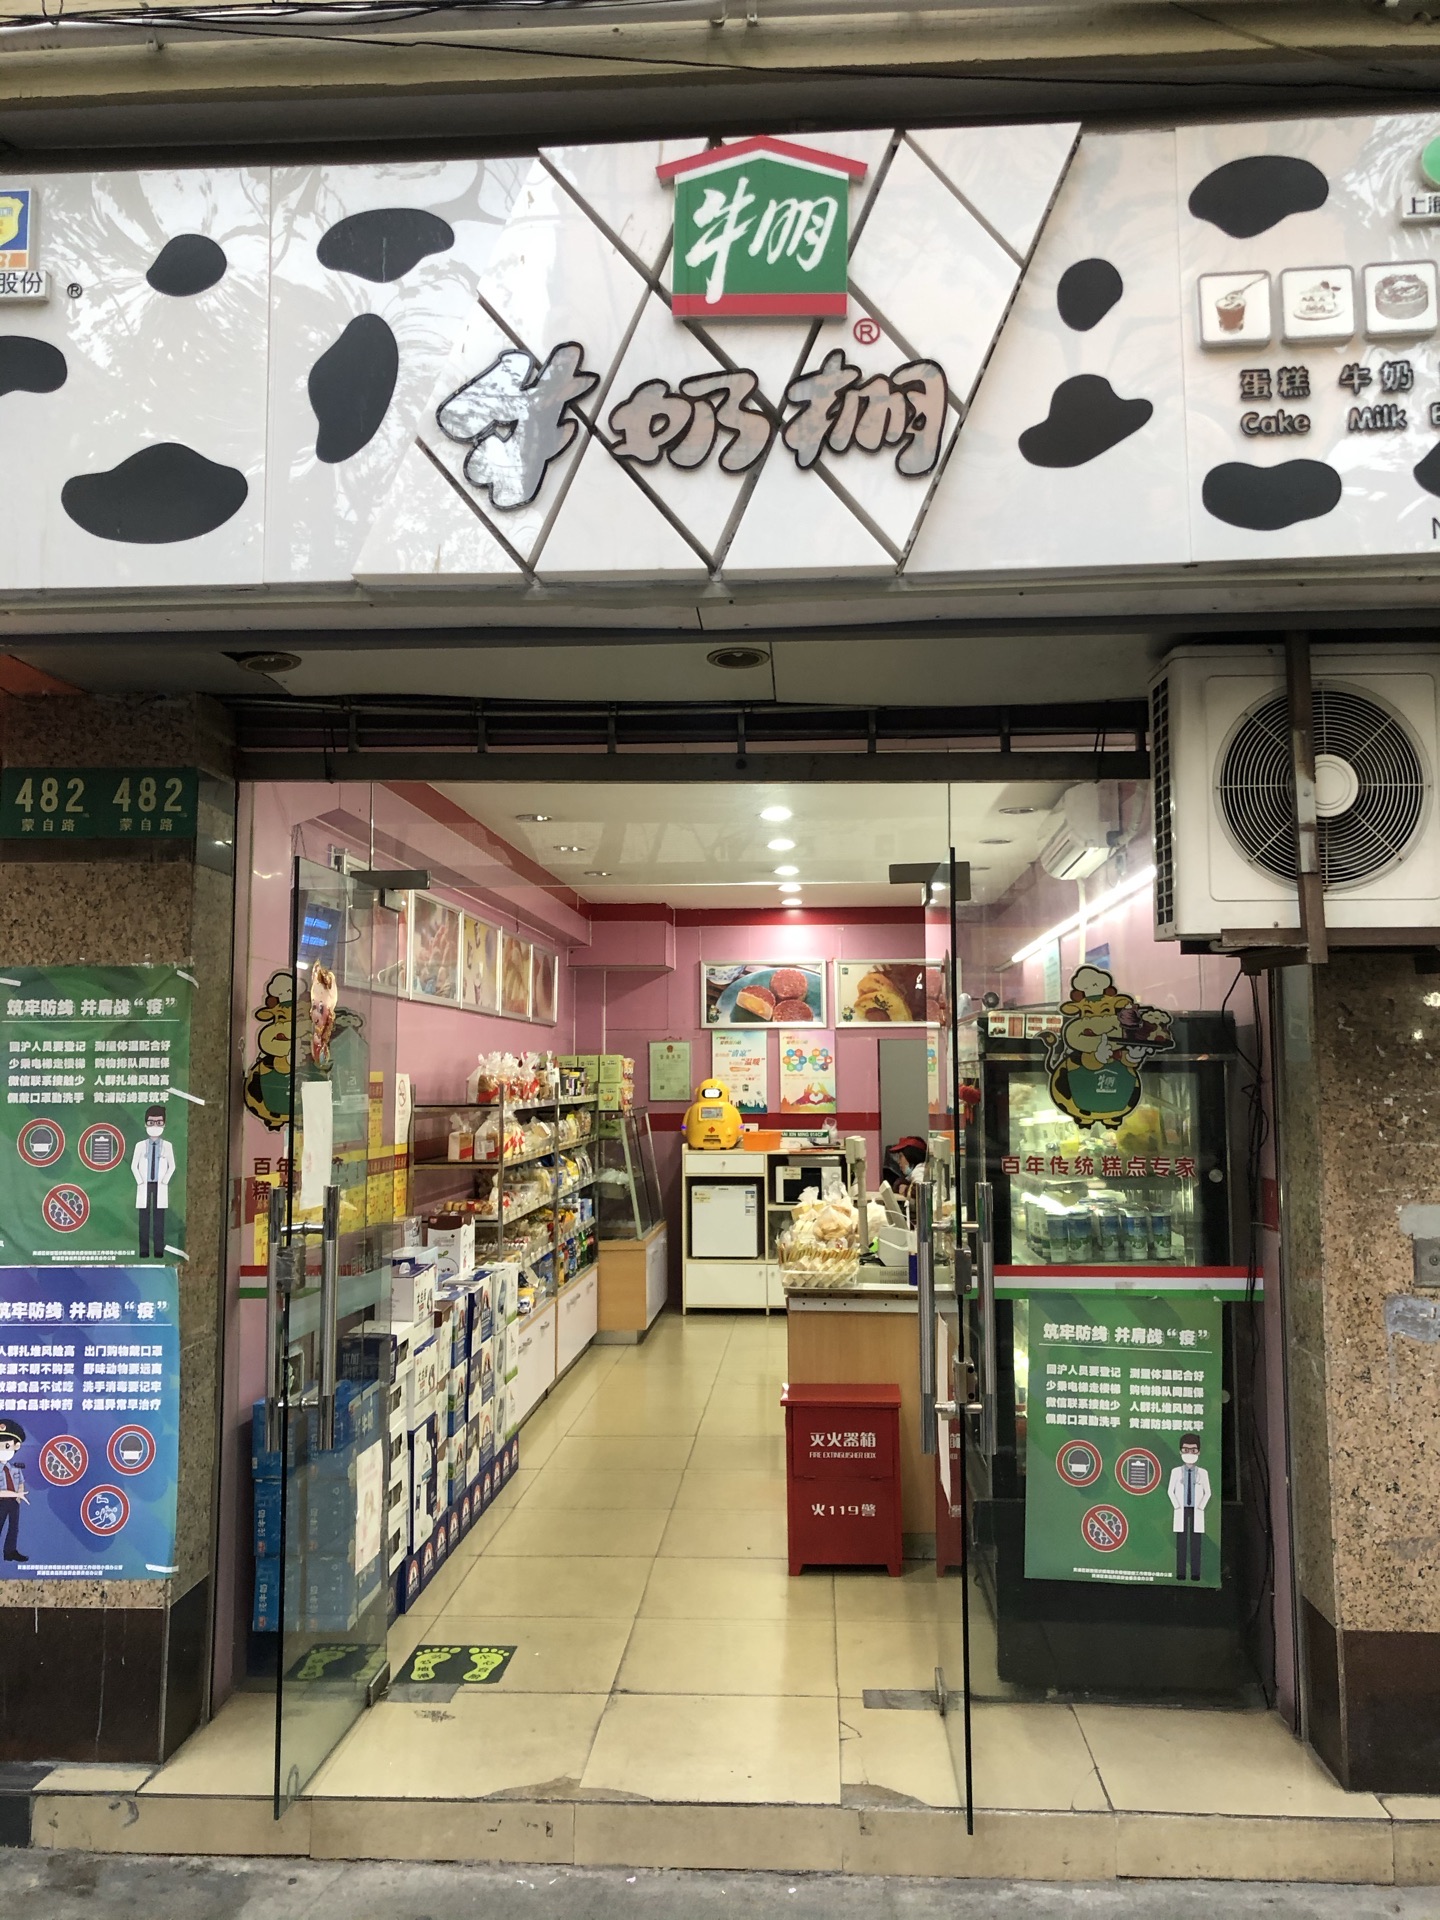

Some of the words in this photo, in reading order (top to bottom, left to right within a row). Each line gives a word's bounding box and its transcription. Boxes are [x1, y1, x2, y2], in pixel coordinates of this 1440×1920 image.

[1240, 366, 1311, 400] 蛋糕
[1339, 360, 1414, 396] 牛奶
[1240, 409, 1311, 439] Cake
[1348, 404, 1408, 432] Milk
[15, 778, 84, 812] 482
[113, 777, 183, 812] 482
[21, 818, 75, 832] 蒙自路
[119, 818, 173, 832] 蒙自路
[7, 999, 74, 1016] 筑牢防线
[1002, 1155, 1094, 1175] 百年传统
[1101, 1155, 1196, 1178] 糕点专家
[1043, 1323, 1108, 1342] 筑牢防线
[810, 1432, 877, 1448] 灭火器箱
